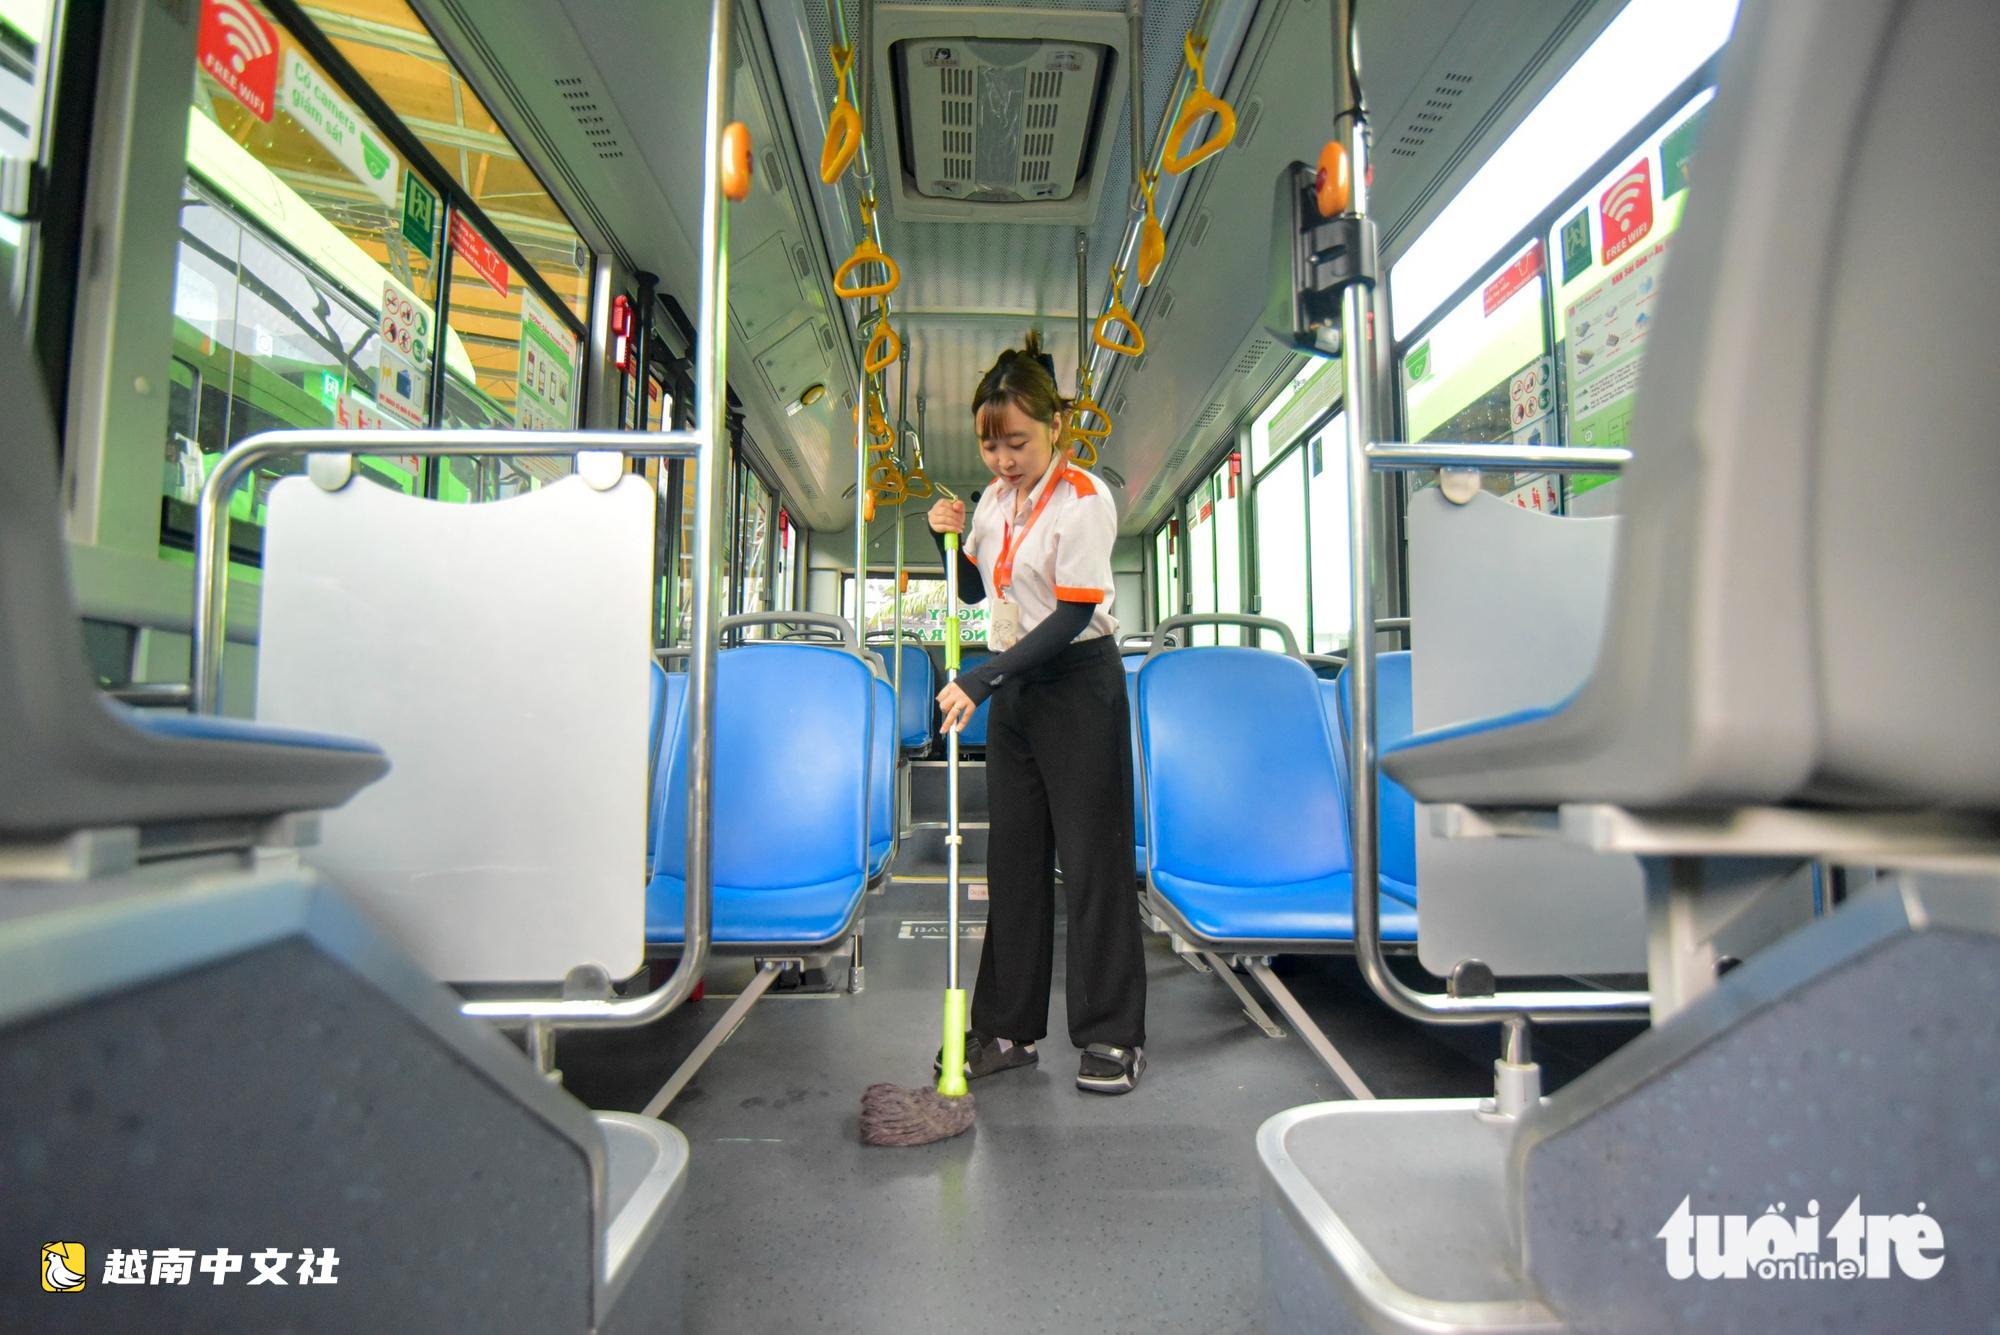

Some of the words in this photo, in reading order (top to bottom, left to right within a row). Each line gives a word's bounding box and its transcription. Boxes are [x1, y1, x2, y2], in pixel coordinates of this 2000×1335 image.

[206, 53, 238, 91] FREE
[239, 83, 265, 114] WIFI
[295, 61, 312, 90] Có
[314, 86, 356, 135] camera
[292, 89, 322, 126] giám
[326, 122, 343, 145] sát
[1606, 237, 1627, 261] FREE
[1628, 222, 1647, 243] WIFI
